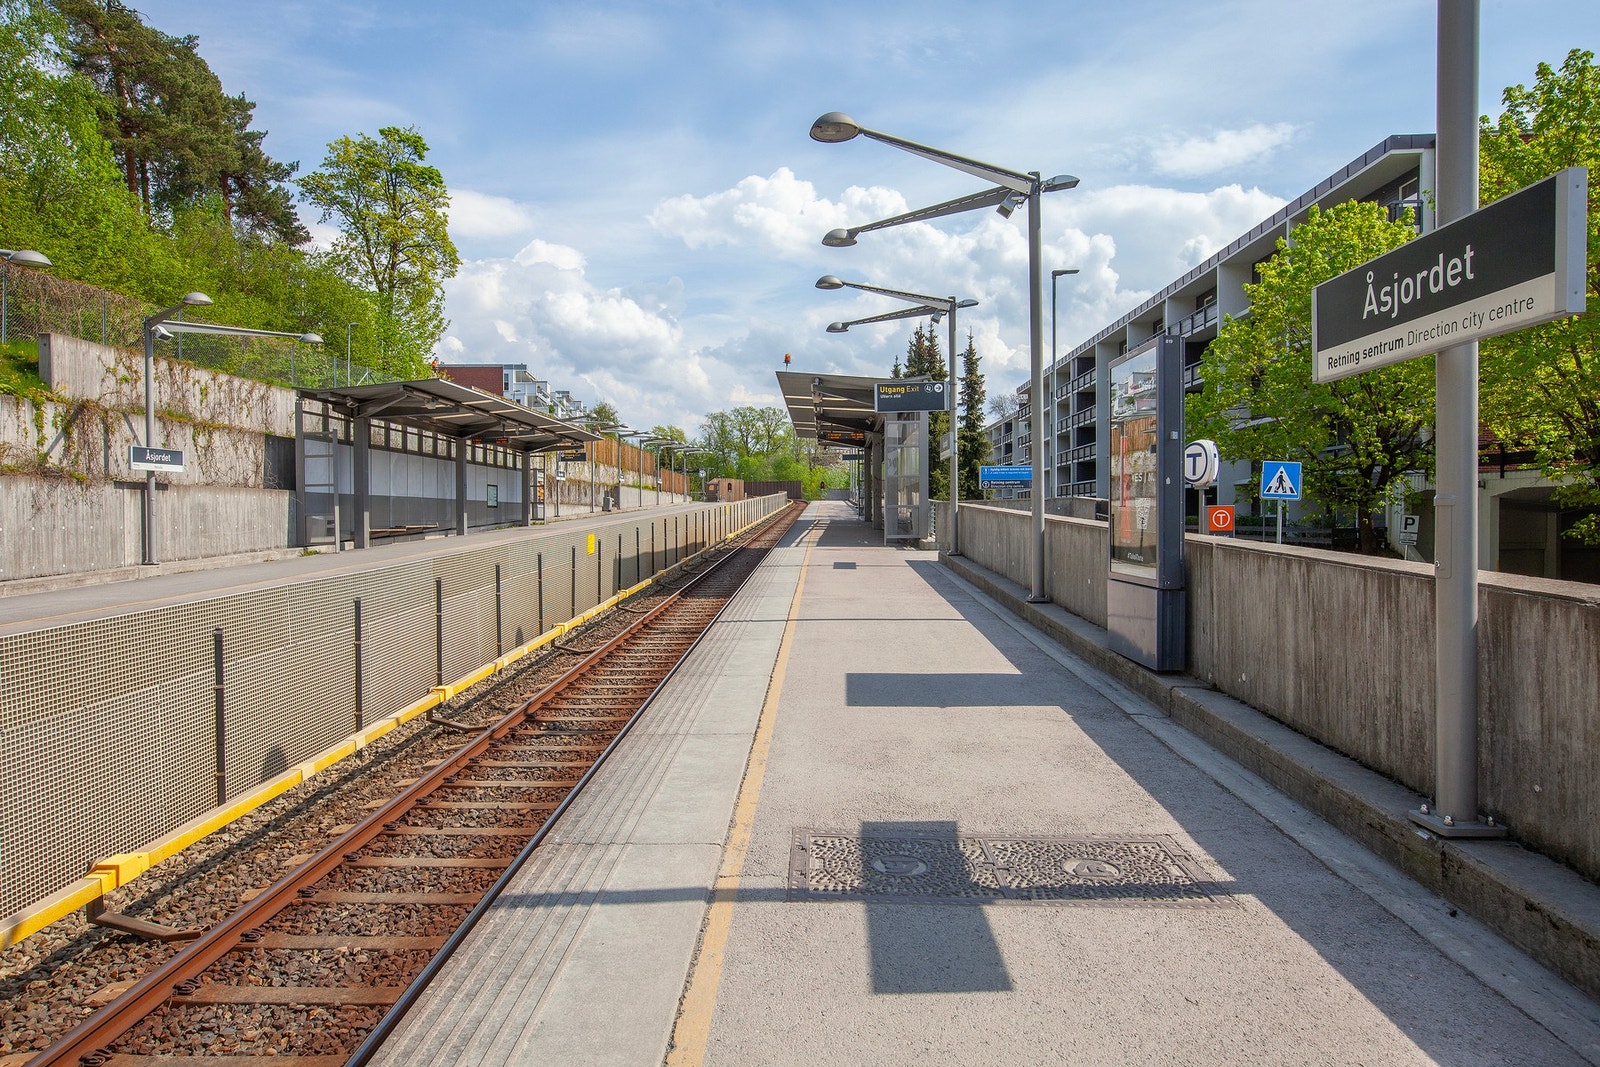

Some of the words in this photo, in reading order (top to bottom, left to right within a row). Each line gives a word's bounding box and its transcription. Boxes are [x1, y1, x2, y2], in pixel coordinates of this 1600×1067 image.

[1362, 244, 1475, 320] Åsjordet
[1327, 351, 1360, 370] Retning
[1362, 337, 1404, 360] sentrum
[1407, 321, 1458, 346] Direction
[1462, 311, 1485, 330] city
[1488, 297, 1535, 321] centre
[880, 386, 905, 394] Utgang
[145, 449, 171, 462] Åsjordet
[1186, 452, 1202, 476] T
[1404, 516, 1416, 531] P
